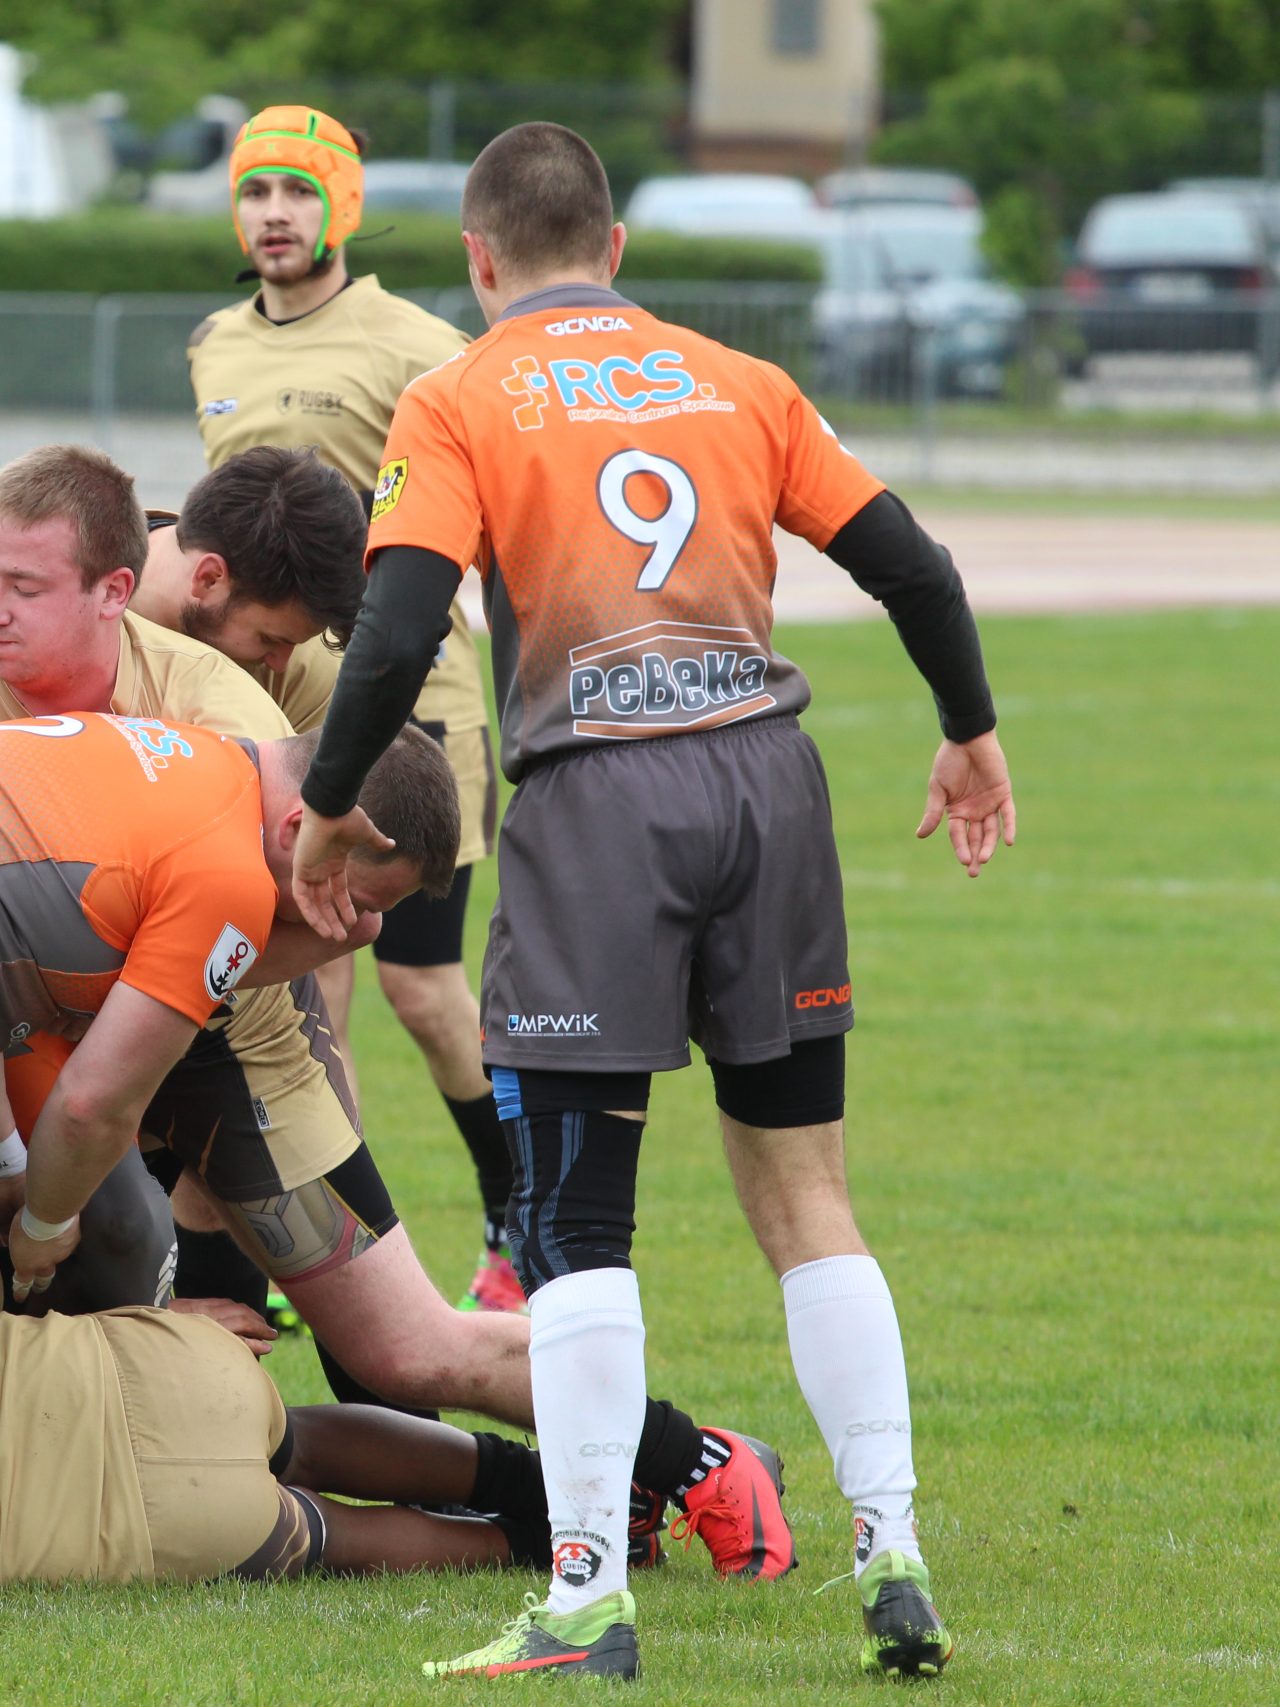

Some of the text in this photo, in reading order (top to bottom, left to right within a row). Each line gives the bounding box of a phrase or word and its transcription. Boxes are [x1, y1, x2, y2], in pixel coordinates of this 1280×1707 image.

[548, 350, 695, 410] RCS
[628, 403, 680, 424] Centrum
[597, 448, 698, 592] 9
[519, 1013, 599, 1032] MPWiK
[582, 1531, 610, 1550] RUGBY
[562, 1562, 587, 1571] LUBIN
